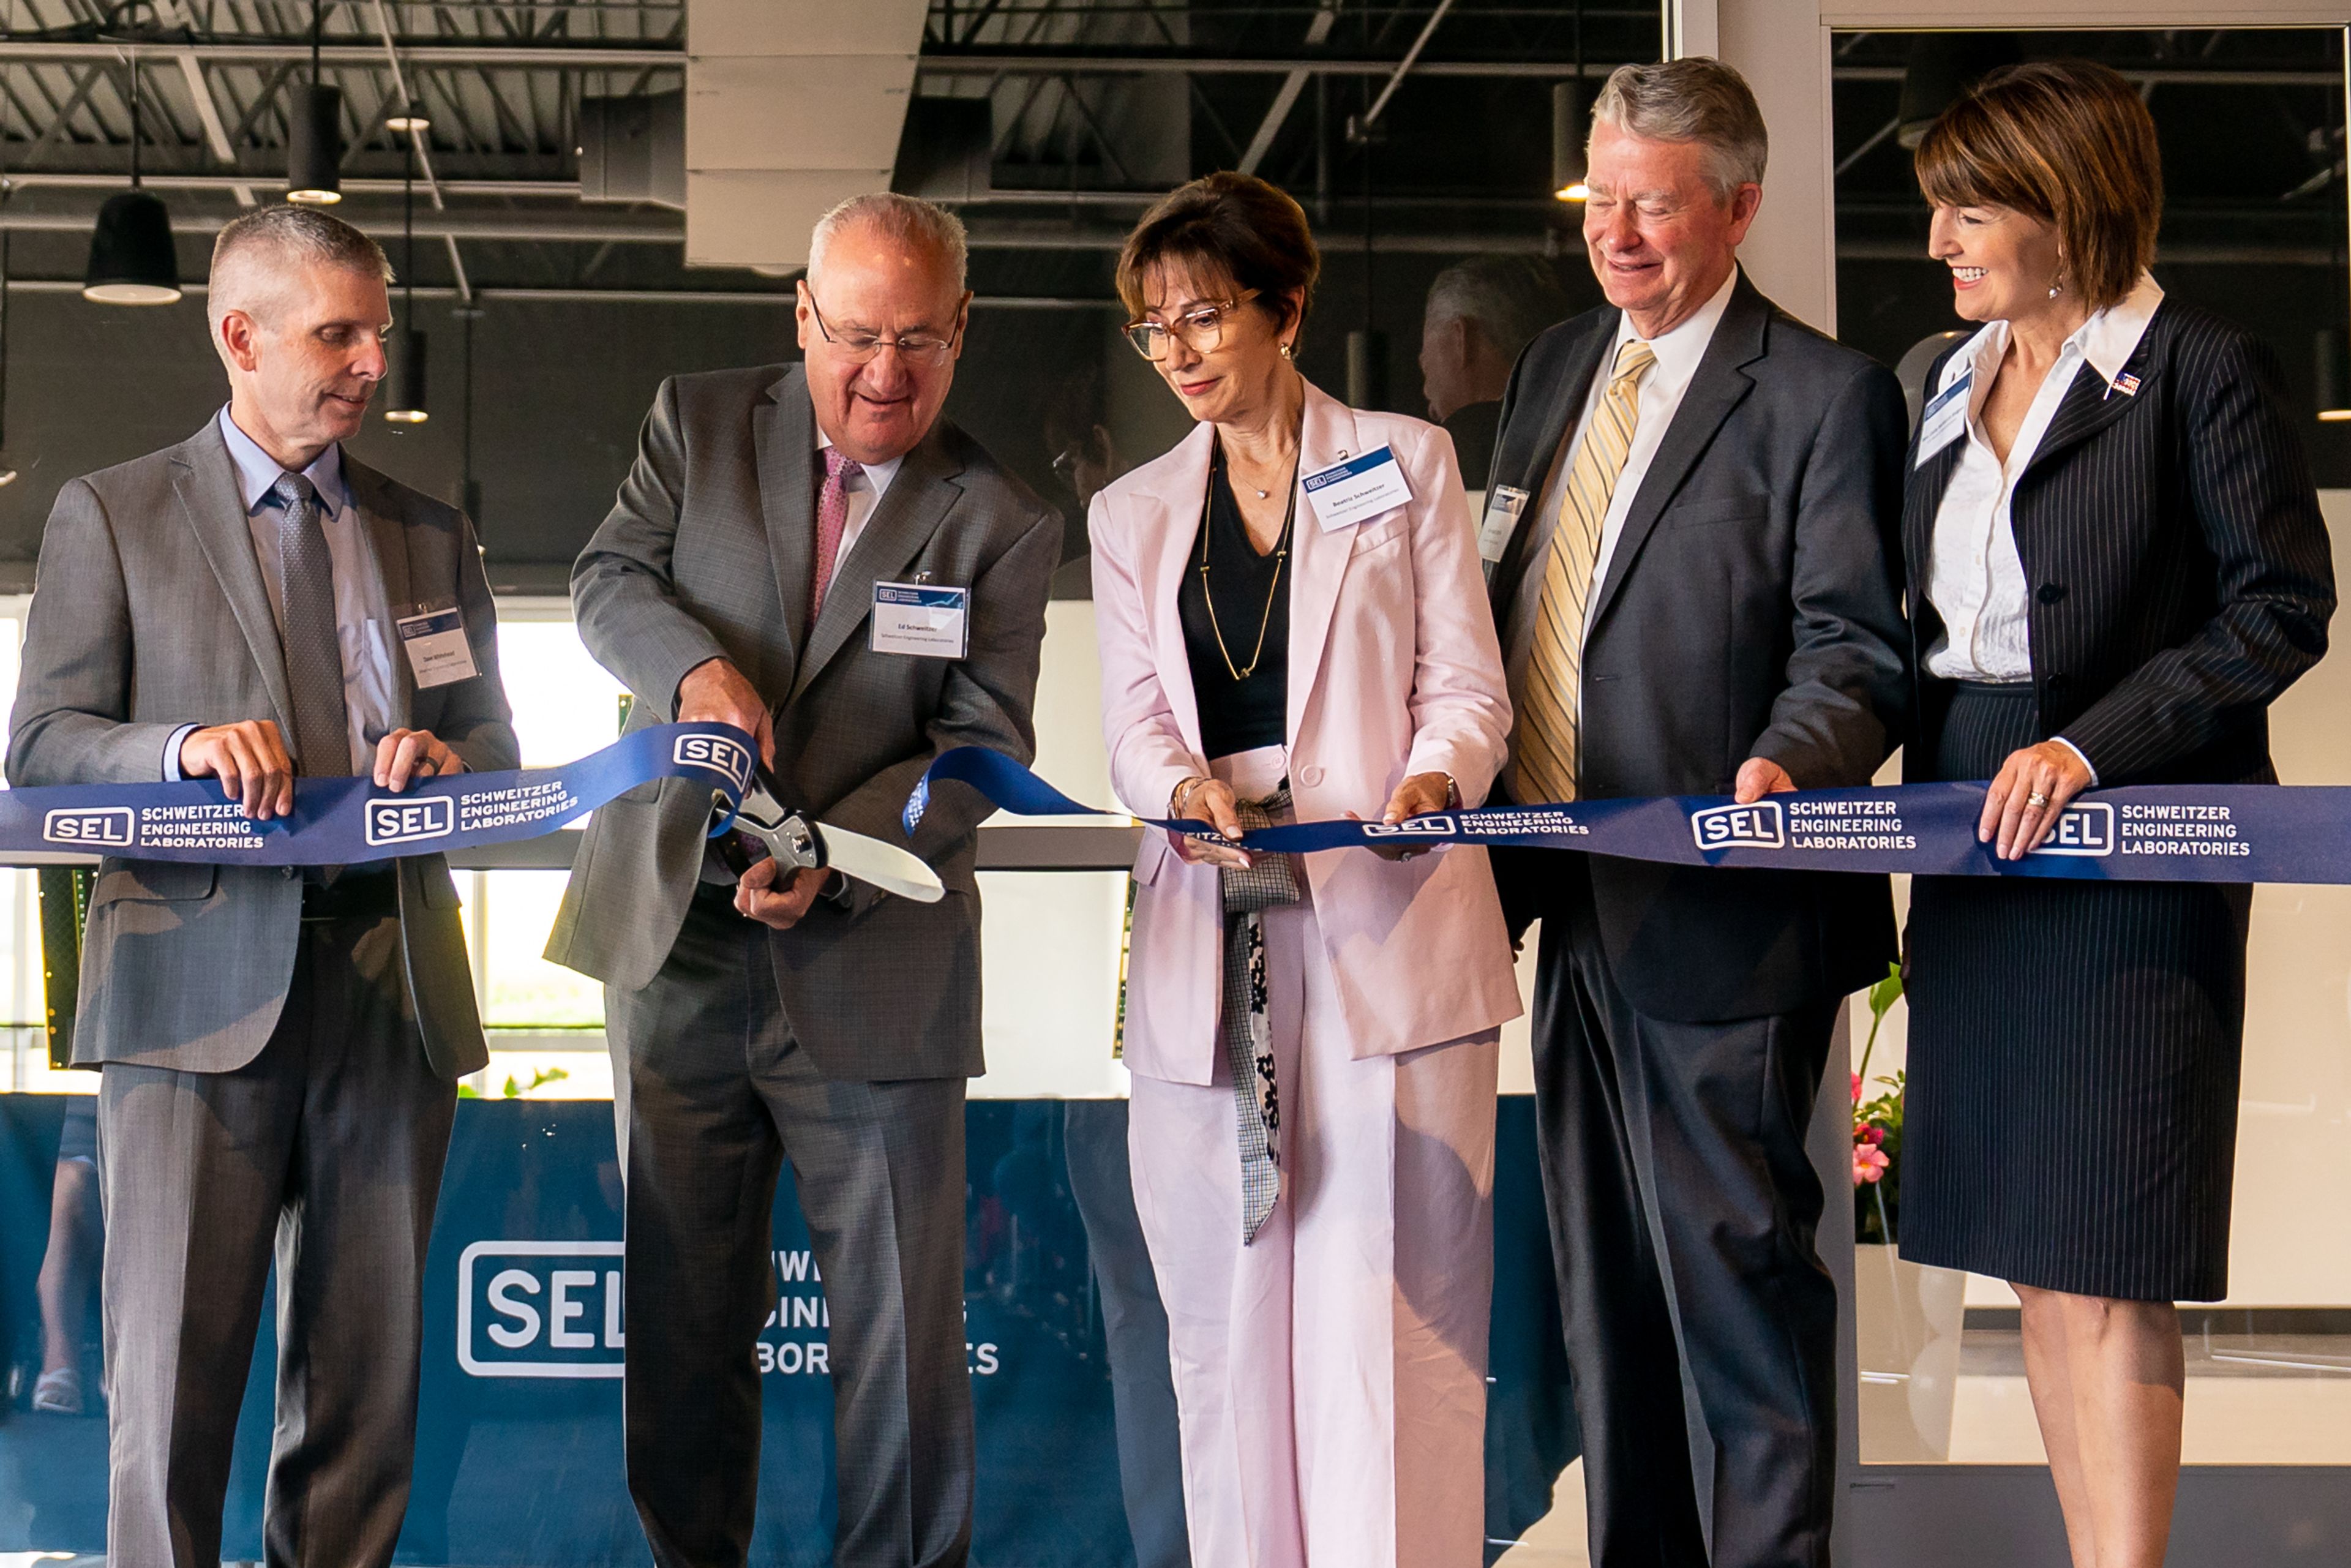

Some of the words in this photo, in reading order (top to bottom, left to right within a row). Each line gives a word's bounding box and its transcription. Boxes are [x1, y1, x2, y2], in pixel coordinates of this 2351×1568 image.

[1354, 484, 1385, 499] Schweitzer
[882, 591, 894, 599] SEL
[686, 740, 743, 781] SEL
[461, 781, 563, 805] SCHWEITZER
[461, 790, 568, 818] ENGINEERING
[1790, 801, 1897, 815] SCHWEITZER
[141, 804, 244, 821] SCHWEITZER
[461, 797, 579, 831] LABORATORIES
[1460, 811, 1564, 820] SCHWEITZER
[2122, 805, 2230, 820] SCHWEITZER
[56, 817, 122, 840] SEL
[141, 821, 251, 835] ENGINEERING
[377, 806, 443, 837] SEL
[1461, 817, 1573, 827] ENGINEERING
[1704, 810, 1774, 840] SEL
[1790, 819, 1902, 833] ENGINEERING
[1464, 825, 1589, 835] LABORATORIES
[2122, 823, 2237, 838] ENGINEERING
[140, 836, 264, 848] LABORATORIES
[1792, 836, 1916, 849] LABORATORIES
[2122, 840, 2250, 856] LABORATORIES
[488, 1269, 625, 1348] SEL
